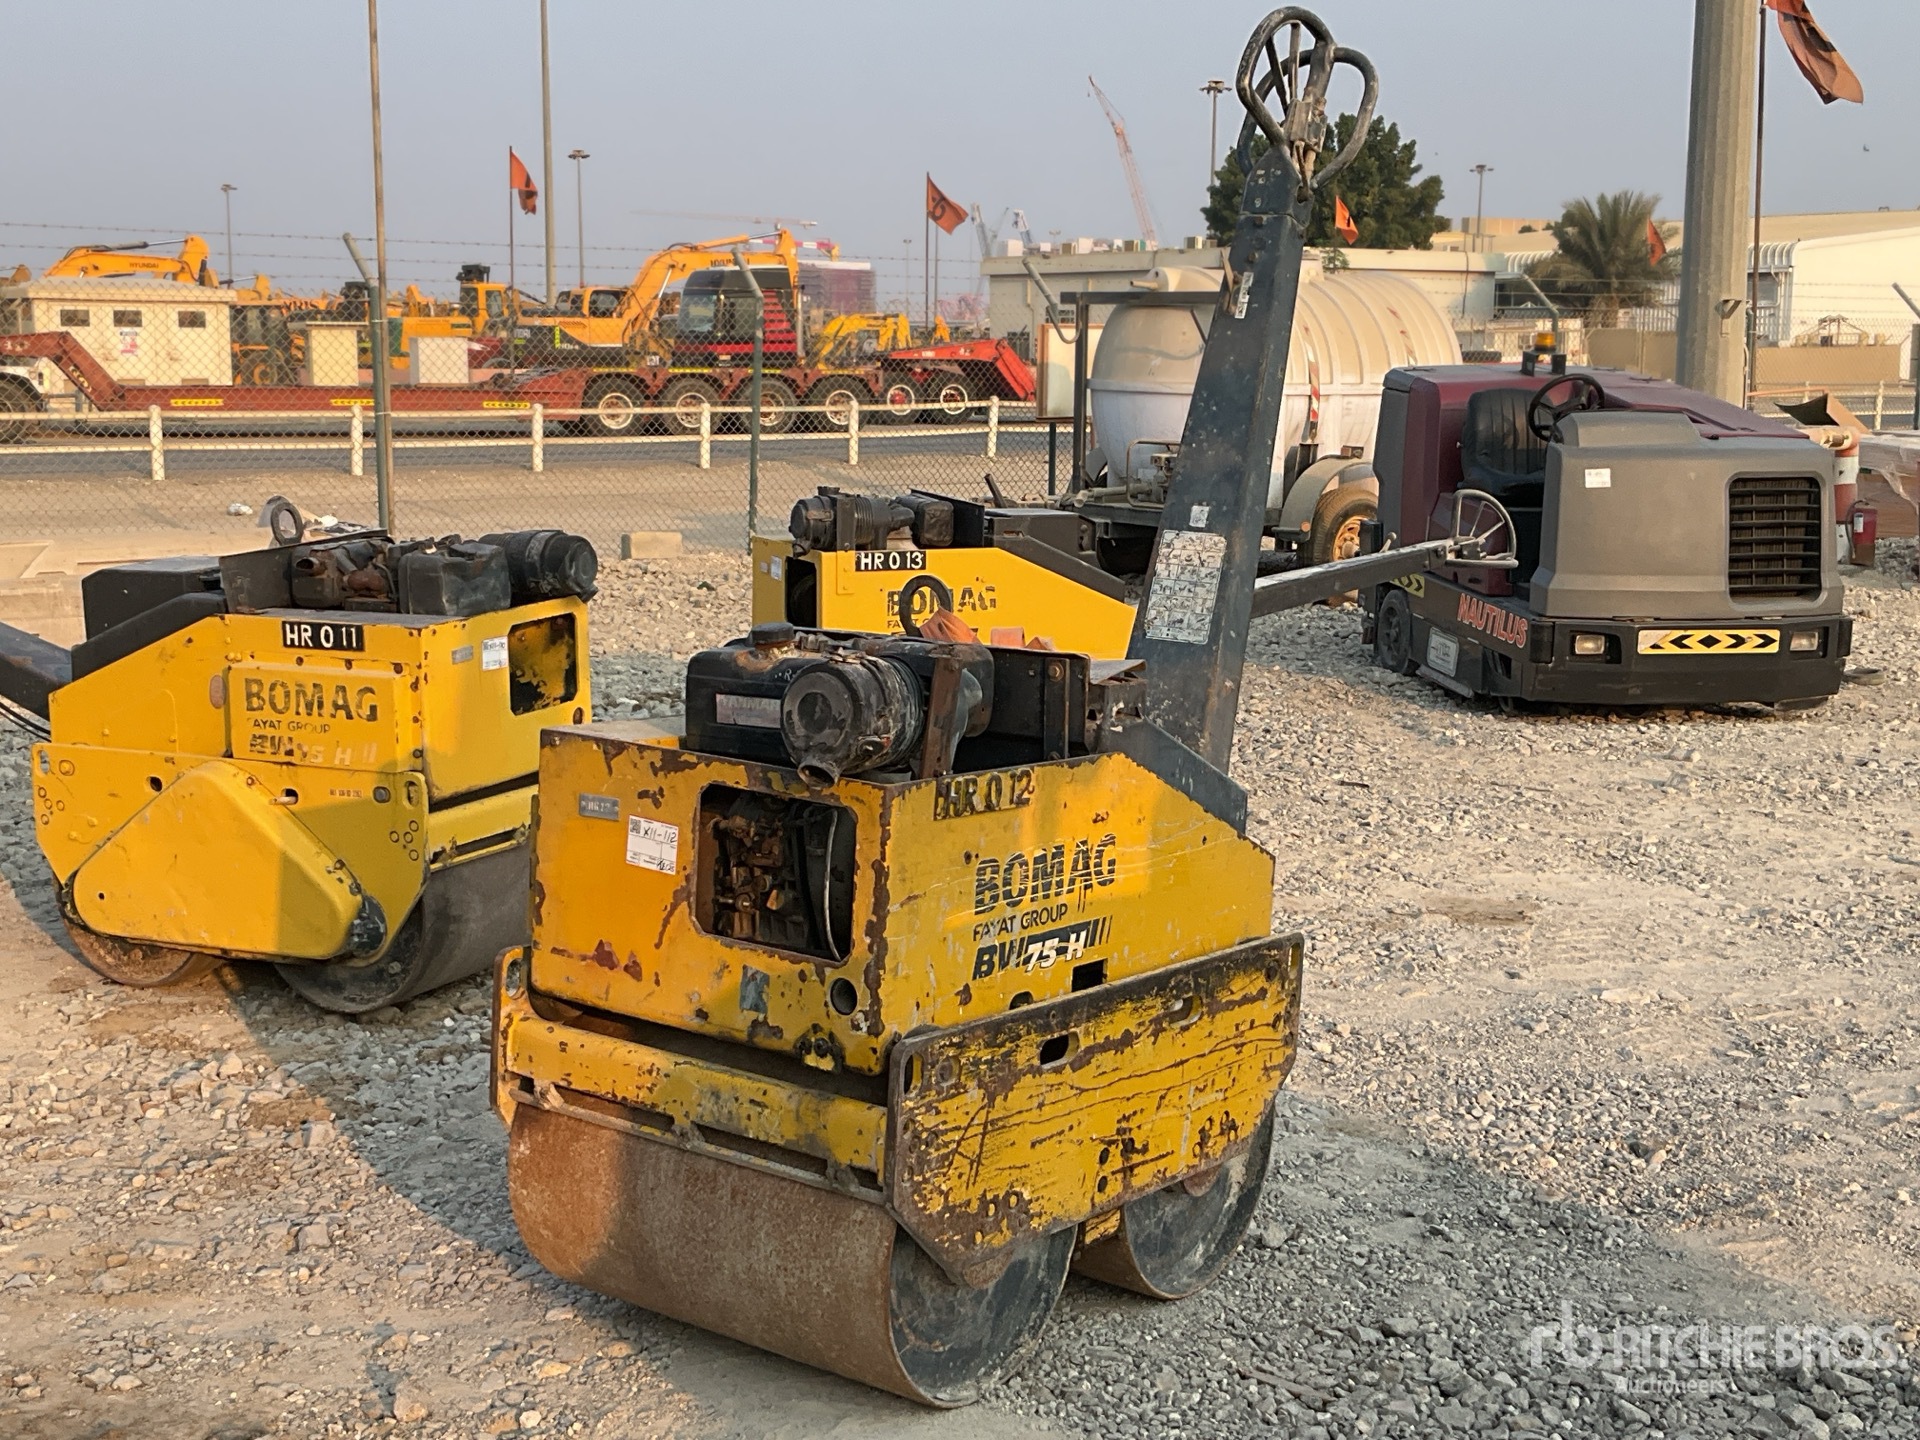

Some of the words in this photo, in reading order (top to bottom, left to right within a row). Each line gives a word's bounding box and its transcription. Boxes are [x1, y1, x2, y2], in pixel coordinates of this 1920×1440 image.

[860, 551, 883, 570] HR
[285, 623, 313, 647] HR
[1457, 592, 1528, 648] NAUTILUS
[244, 678, 379, 722] BOMAG
[247, 717, 282, 731] AYAT
[288, 720, 331, 734] GROUP
[973, 833, 1117, 916] BOMAG
[972, 914, 1017, 942] FAYAT
[1020, 902, 1069, 930] GROUP
